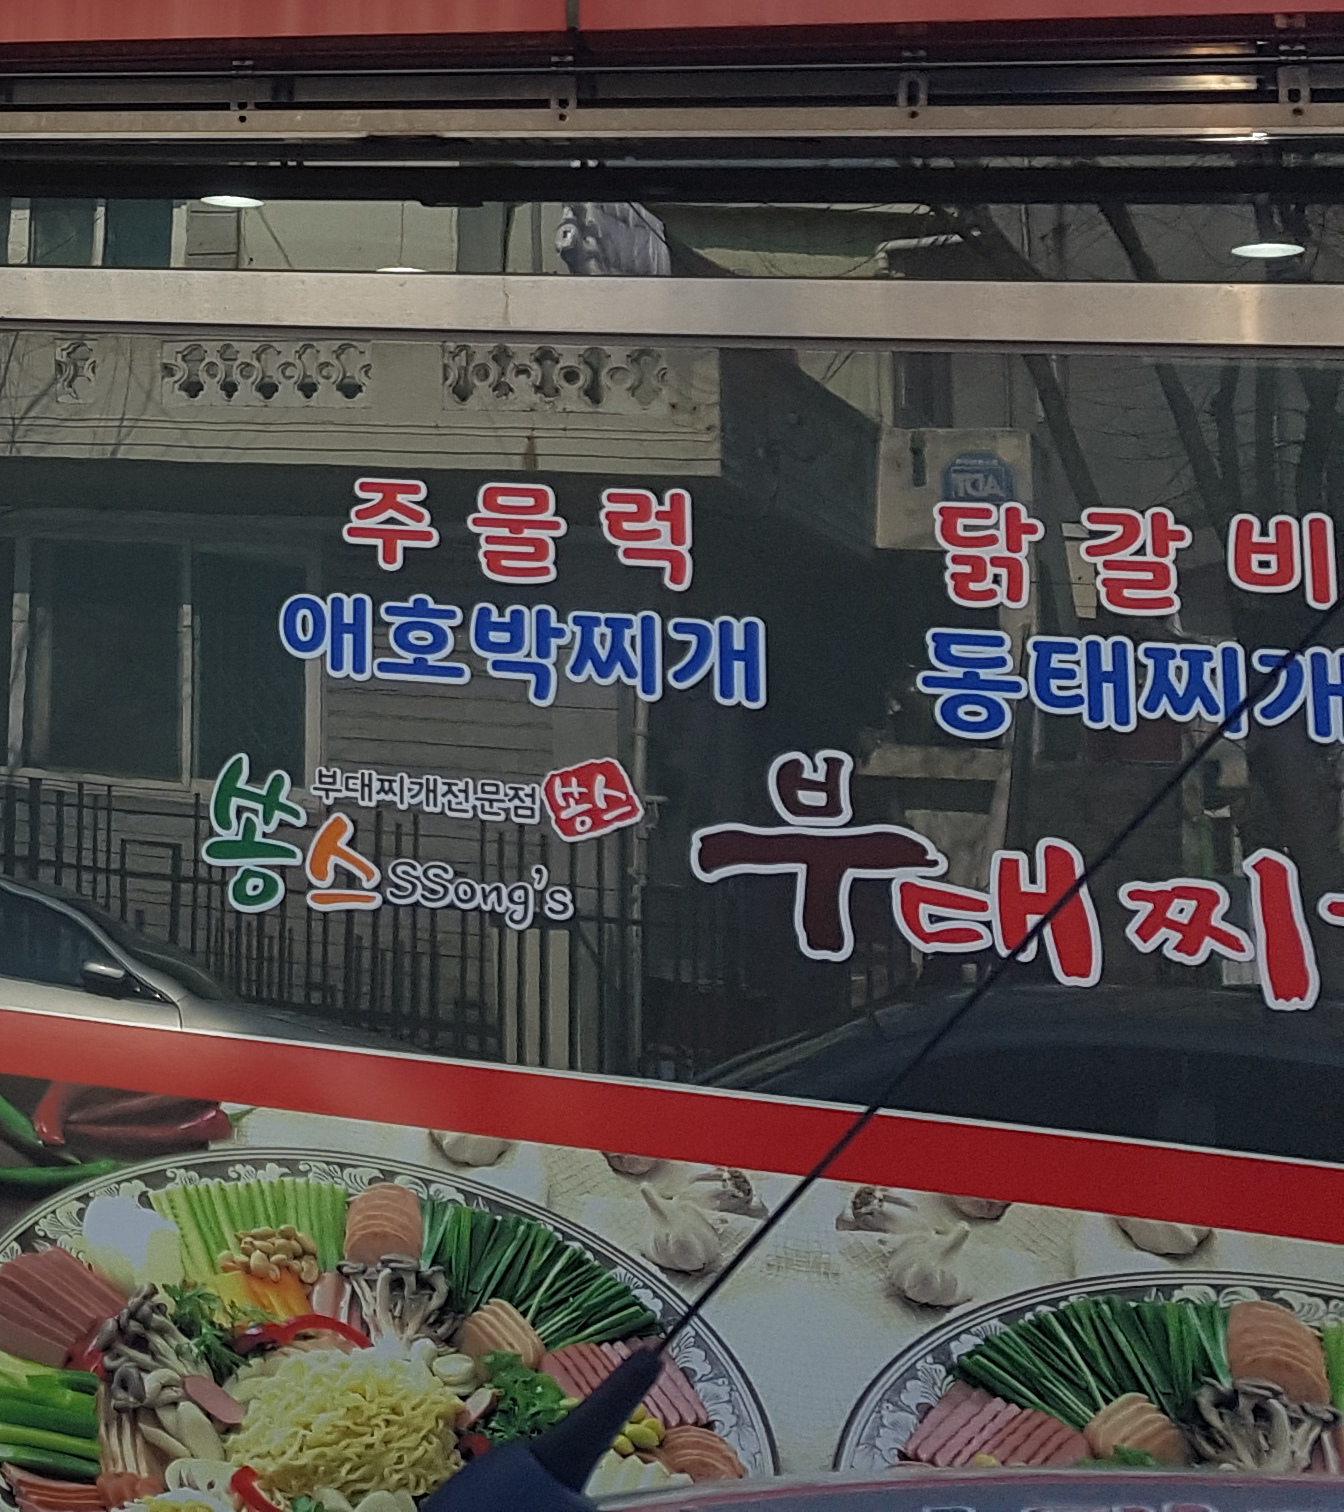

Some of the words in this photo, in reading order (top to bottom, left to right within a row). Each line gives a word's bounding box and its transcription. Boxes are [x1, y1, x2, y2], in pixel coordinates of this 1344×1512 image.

[340, 476, 694, 591] 주물럭
[933, 500, 1338, 616] 닭갈비
[278, 592, 768, 708] 애호박찌개
[311, 767, 541, 825] 부대찌개전문점
[691, 748, 1344, 1011] 부대찌
